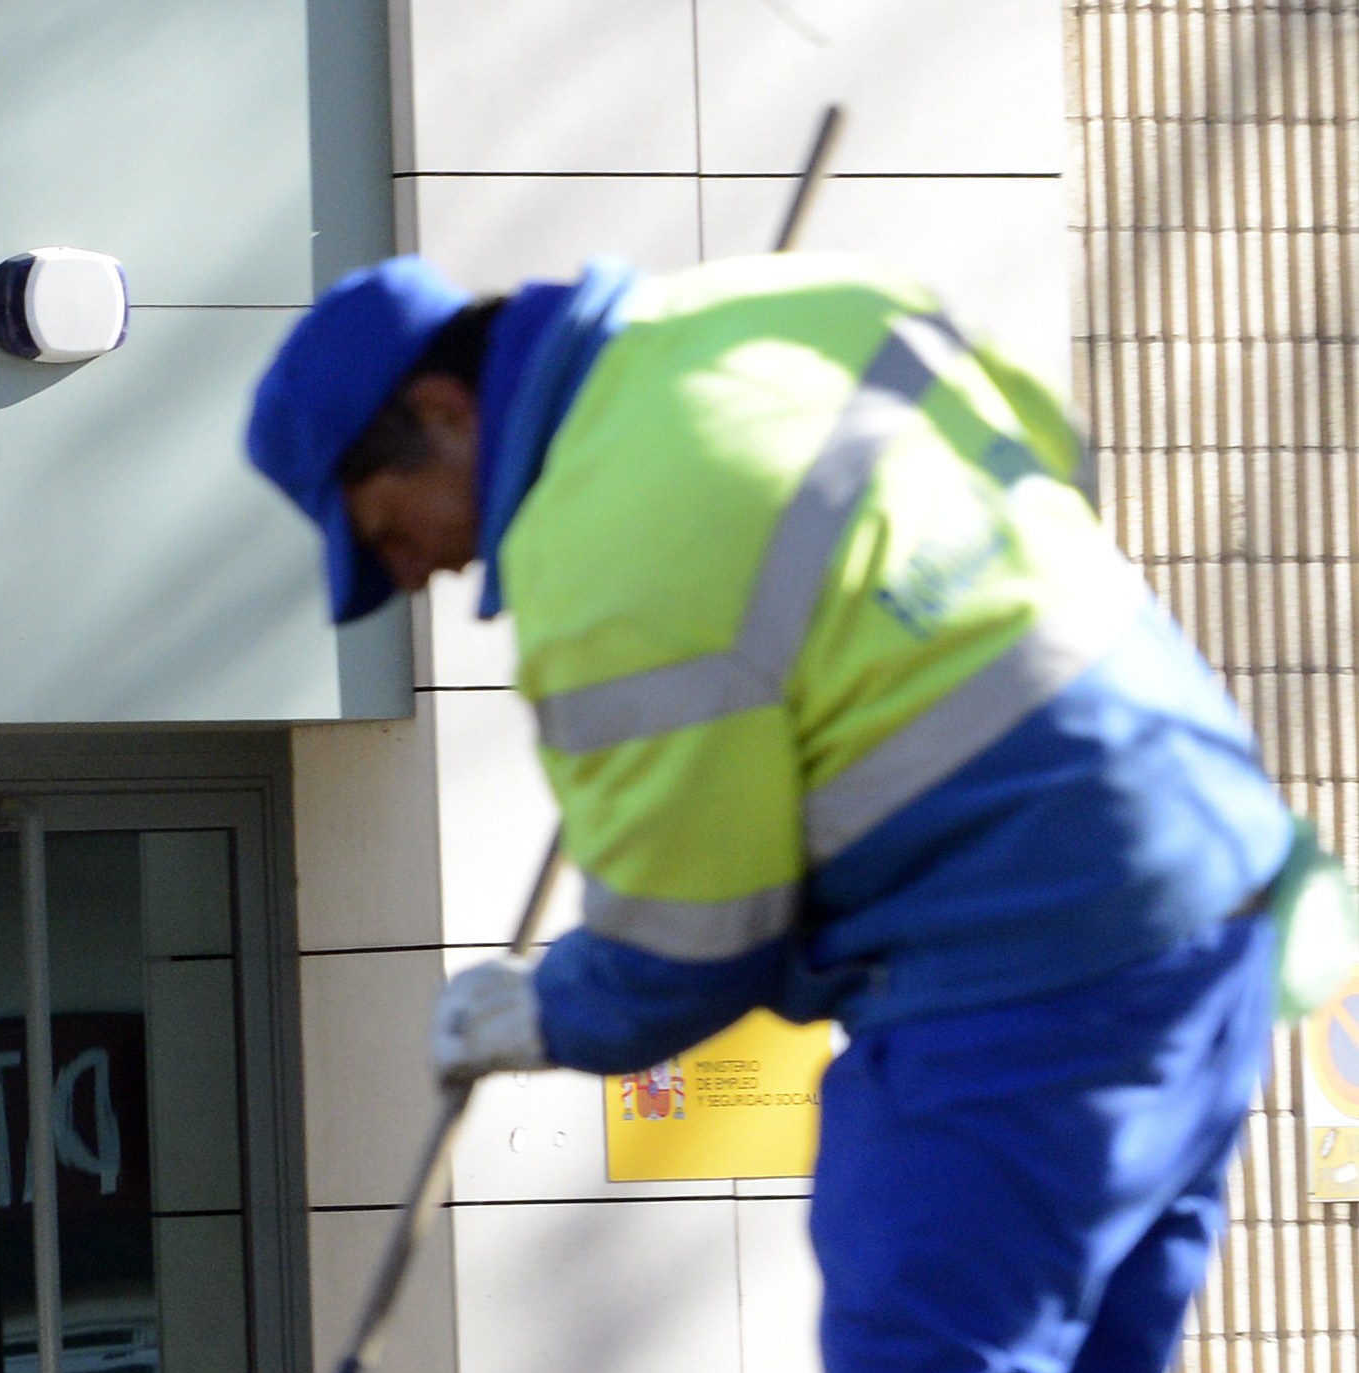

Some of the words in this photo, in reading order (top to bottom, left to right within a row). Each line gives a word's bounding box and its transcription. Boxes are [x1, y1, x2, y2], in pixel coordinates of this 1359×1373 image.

[695, 1060, 759, 1072] MINISTERIO
[697, 1077, 711, 1090] DE
[715, 1076, 758, 1090] EMPLEO
[708, 1093, 771, 1107] SEGURIDAD
[776, 1092, 819, 1106] SOCIAL
